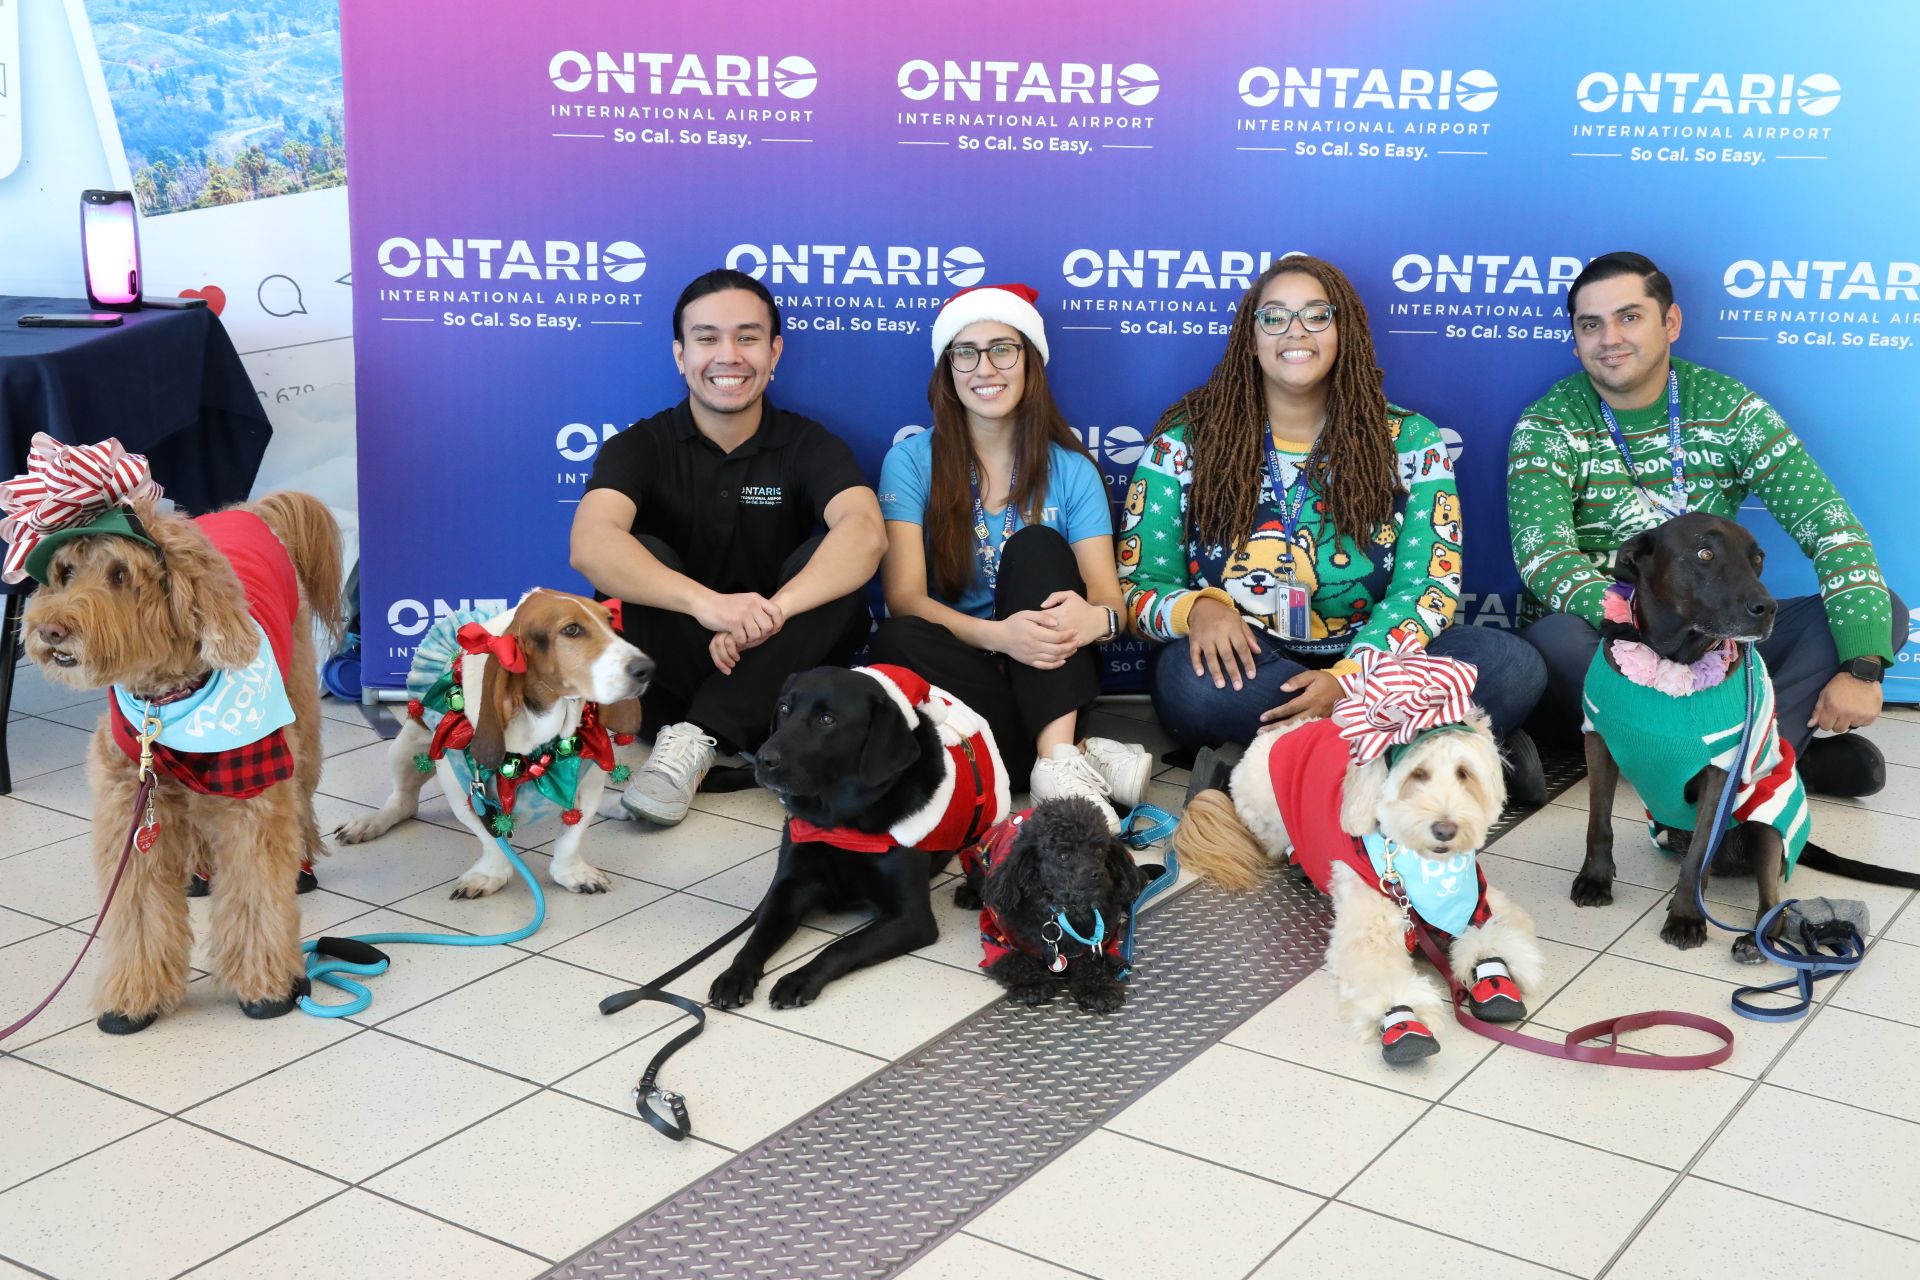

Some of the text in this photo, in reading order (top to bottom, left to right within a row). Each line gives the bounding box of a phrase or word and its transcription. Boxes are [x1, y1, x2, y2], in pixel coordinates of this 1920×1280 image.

[549, 50, 817, 99] ONTARIO
[897, 59, 1160, 106] ONTARIO
[1238, 66, 1498, 112] ONTARIO
[1576, 71, 1841, 117] ONTARIO
[551, 104, 813, 122] INTERNATIONAL AIRPORT
[899, 112, 1154, 129] INTERNATIONAL AIRPORT
[1237, 119, 1491, 135] INTERNATIONAL AIRPORT
[1573, 124, 1832, 140] INTERNATIONAL AIRPORT
[614, 128, 752, 148] So Cal. So Easy.
[958, 136, 1093, 155] So Cal. So Easy.
[1295, 141, 1428, 161] So Cal. So Easy.
[1630, 147, 1766, 166] So Cal. So Easy.
[377, 237, 647, 283] ONTARIO
[725, 243, 986, 287] ONTARIO
[1062, 248, 1309, 290] ONTARI
[1392, 253, 1595, 294] ONTAR
[1723, 259, 1920, 301] ONTAR
[380, 289, 643, 305] INTERNATIONAL AIRPORT
[775, 295, 949, 309] RNATIONAL AIRP
[1062, 299, 1217, 313] INTERNATIONAL
[1390, 303, 1543, 317] INTERNATIONAL
[1719, 309, 1880, 324] INTERNATIONAL
[443, 312, 582, 331] So Cal. So Easy.
[786, 316, 921, 335] So Cal. So Easy.
[1120, 321, 1141, 334] So
[1146, 321, 1177, 335] Cal.
[1182, 321, 1203, 335] So
[1445, 324, 1467, 338] So
[1471, 325, 1502, 339] Cal.
[1507, 325, 1528, 339] So
[1776, 331, 1913, 350] So Cal. So Easy.
[1669, 370, 1679, 404] ONTARIO
[1672, 416, 1681, 448] ONTAR
